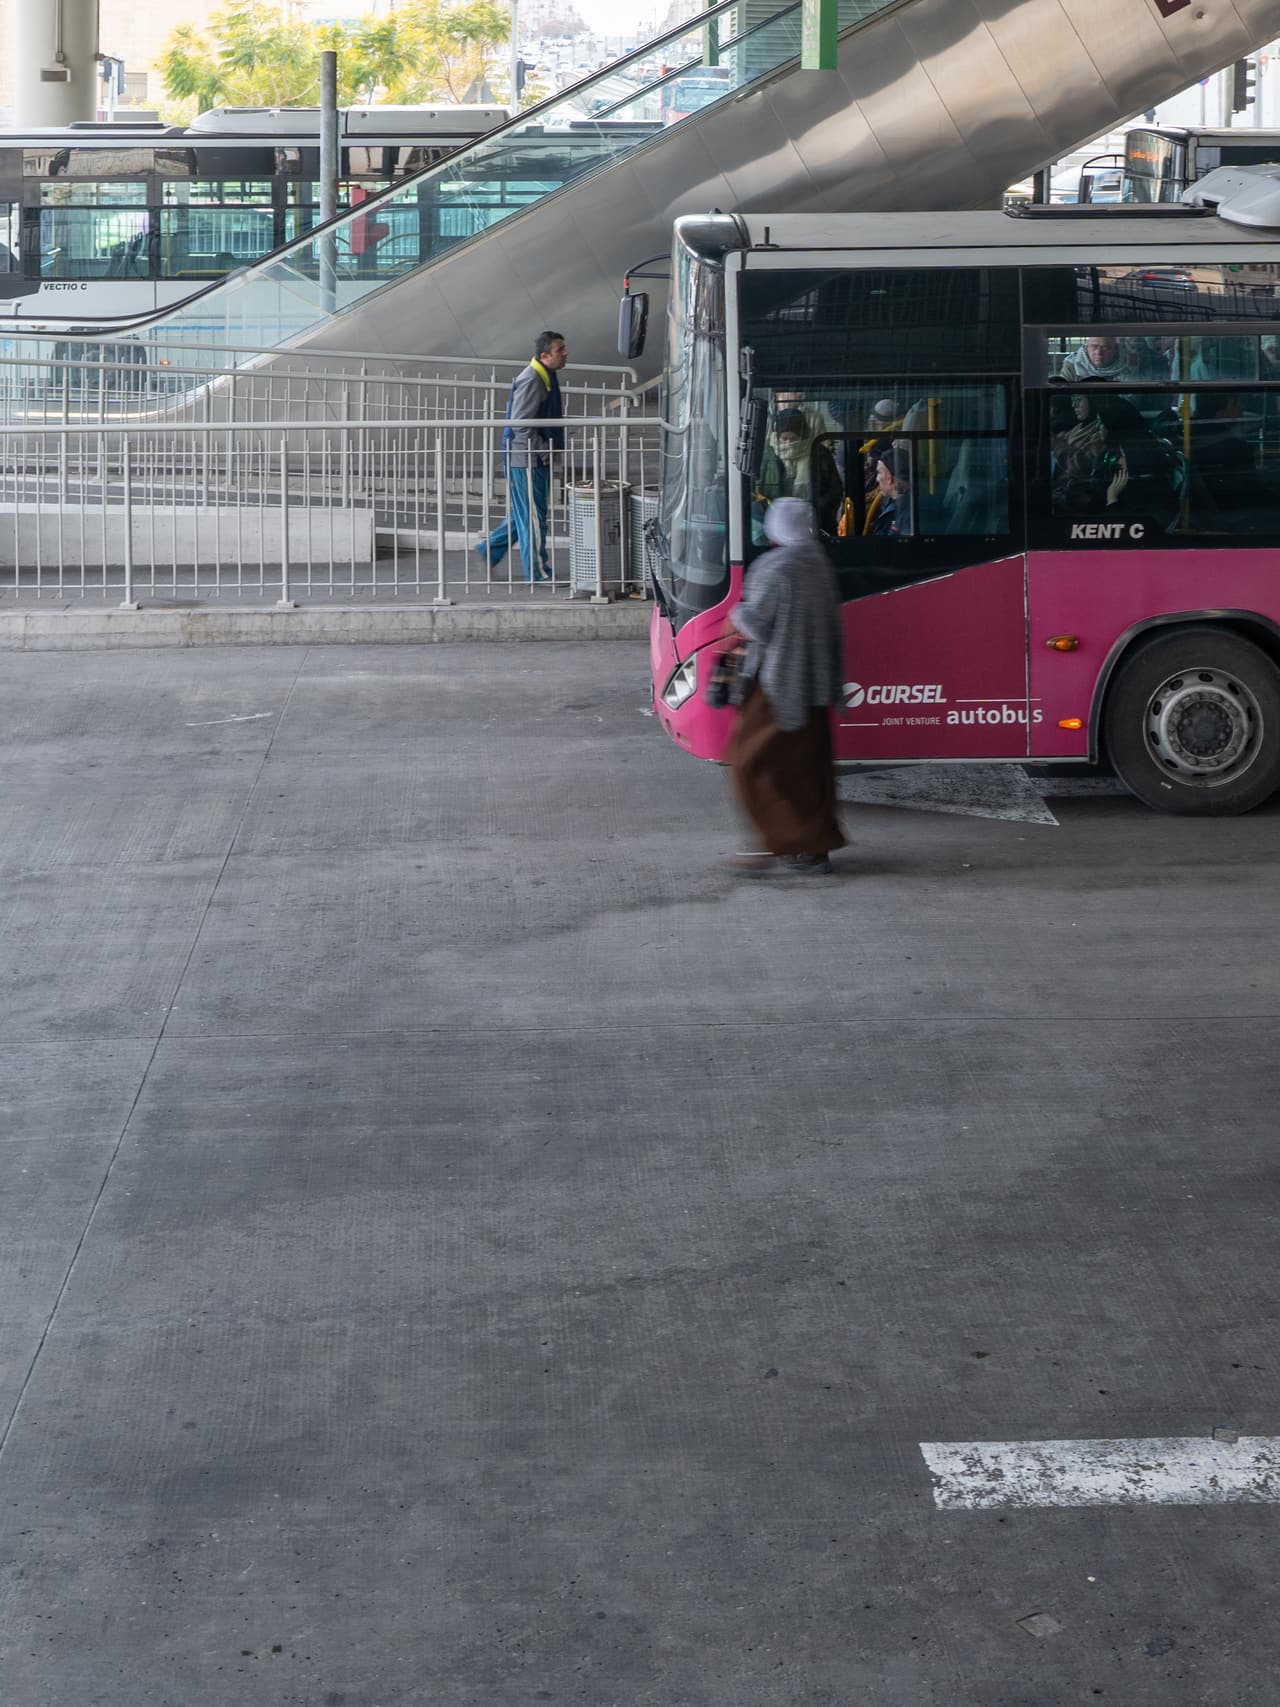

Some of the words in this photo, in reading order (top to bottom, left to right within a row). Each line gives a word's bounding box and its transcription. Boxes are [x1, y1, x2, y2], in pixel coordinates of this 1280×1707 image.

[1071, 523, 1125, 539] KENT
[1129, 523, 1145, 539] C
[866, 685, 947, 705] GÜRSEL
[881, 717, 904, 726] JOINT
[906, 717, 941, 726] VENTURE
[946, 704, 1044, 725] autobus
